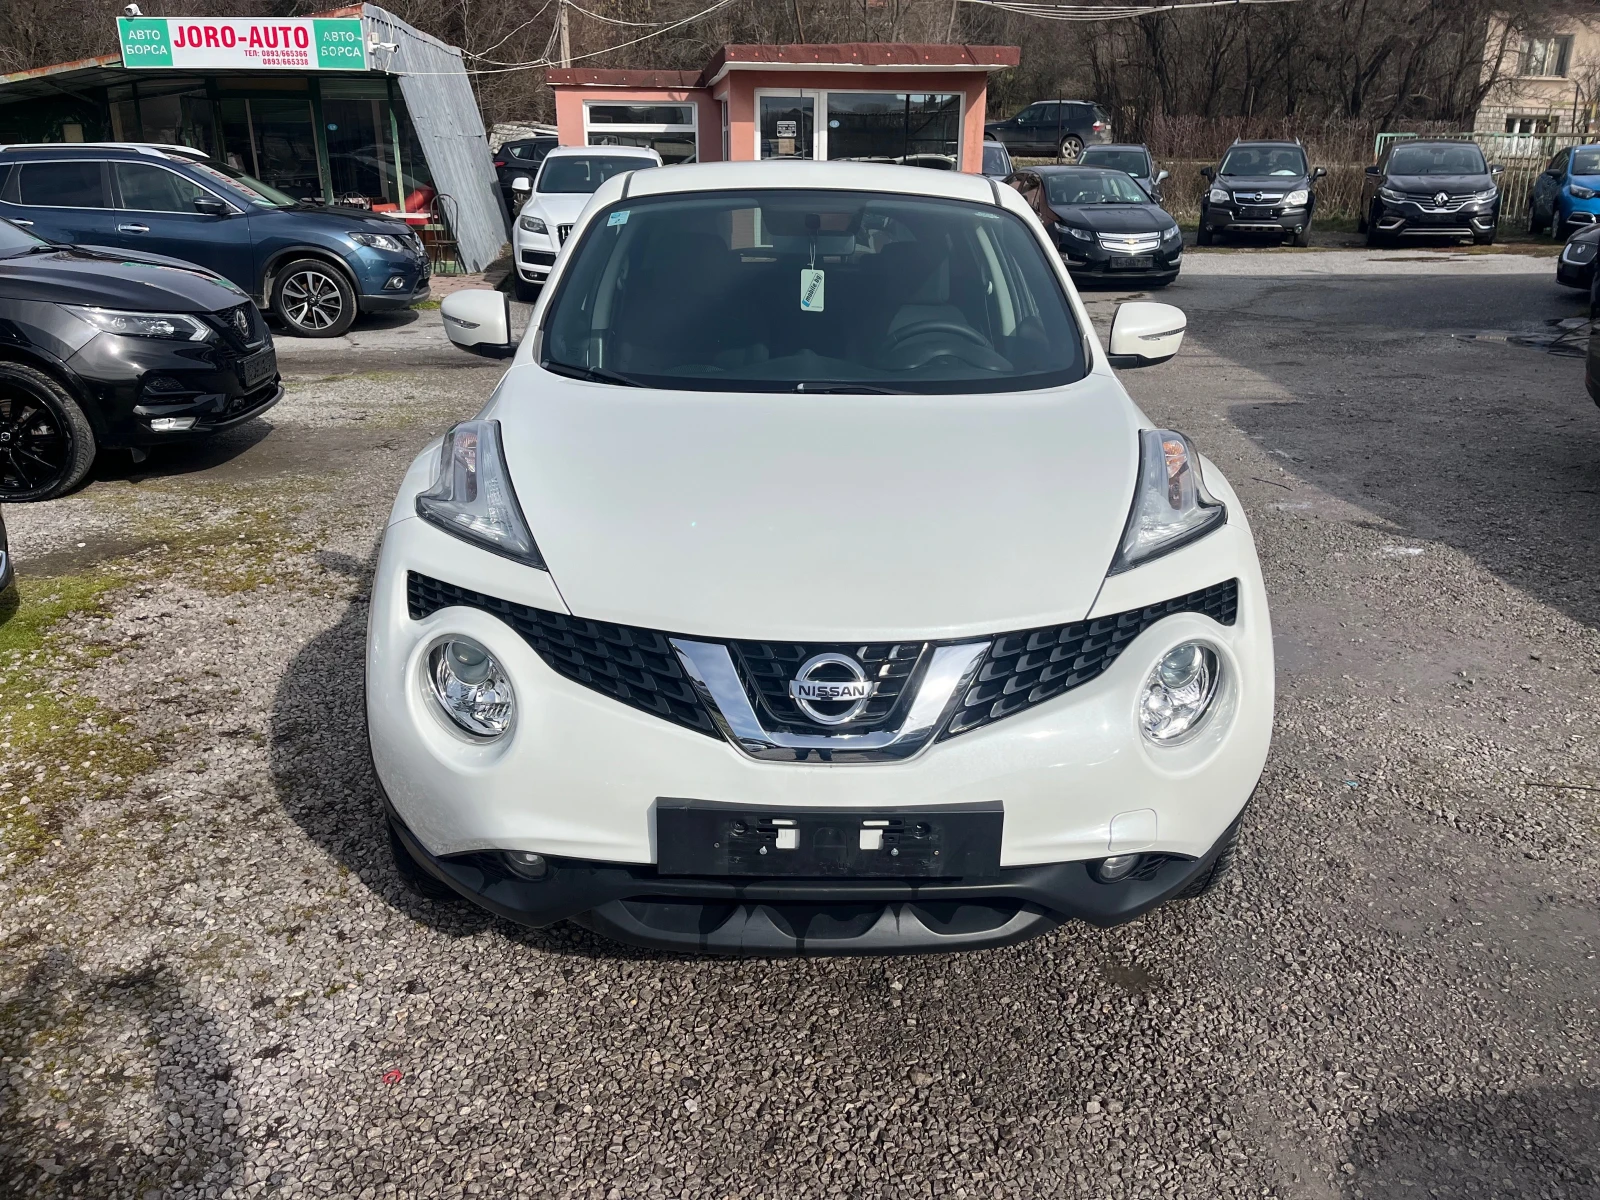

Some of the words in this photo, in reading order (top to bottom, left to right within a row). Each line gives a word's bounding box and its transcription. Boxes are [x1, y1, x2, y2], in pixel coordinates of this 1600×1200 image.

[128, 30, 161, 41] АВТО
[173, 25, 309, 49] JORO-AUTO
[323, 31, 355, 42] АВТО
[125, 44, 168, 55] БОРСА
[320, 46, 362, 57] БОРСА
[798, 685, 865, 697] NISSAN
